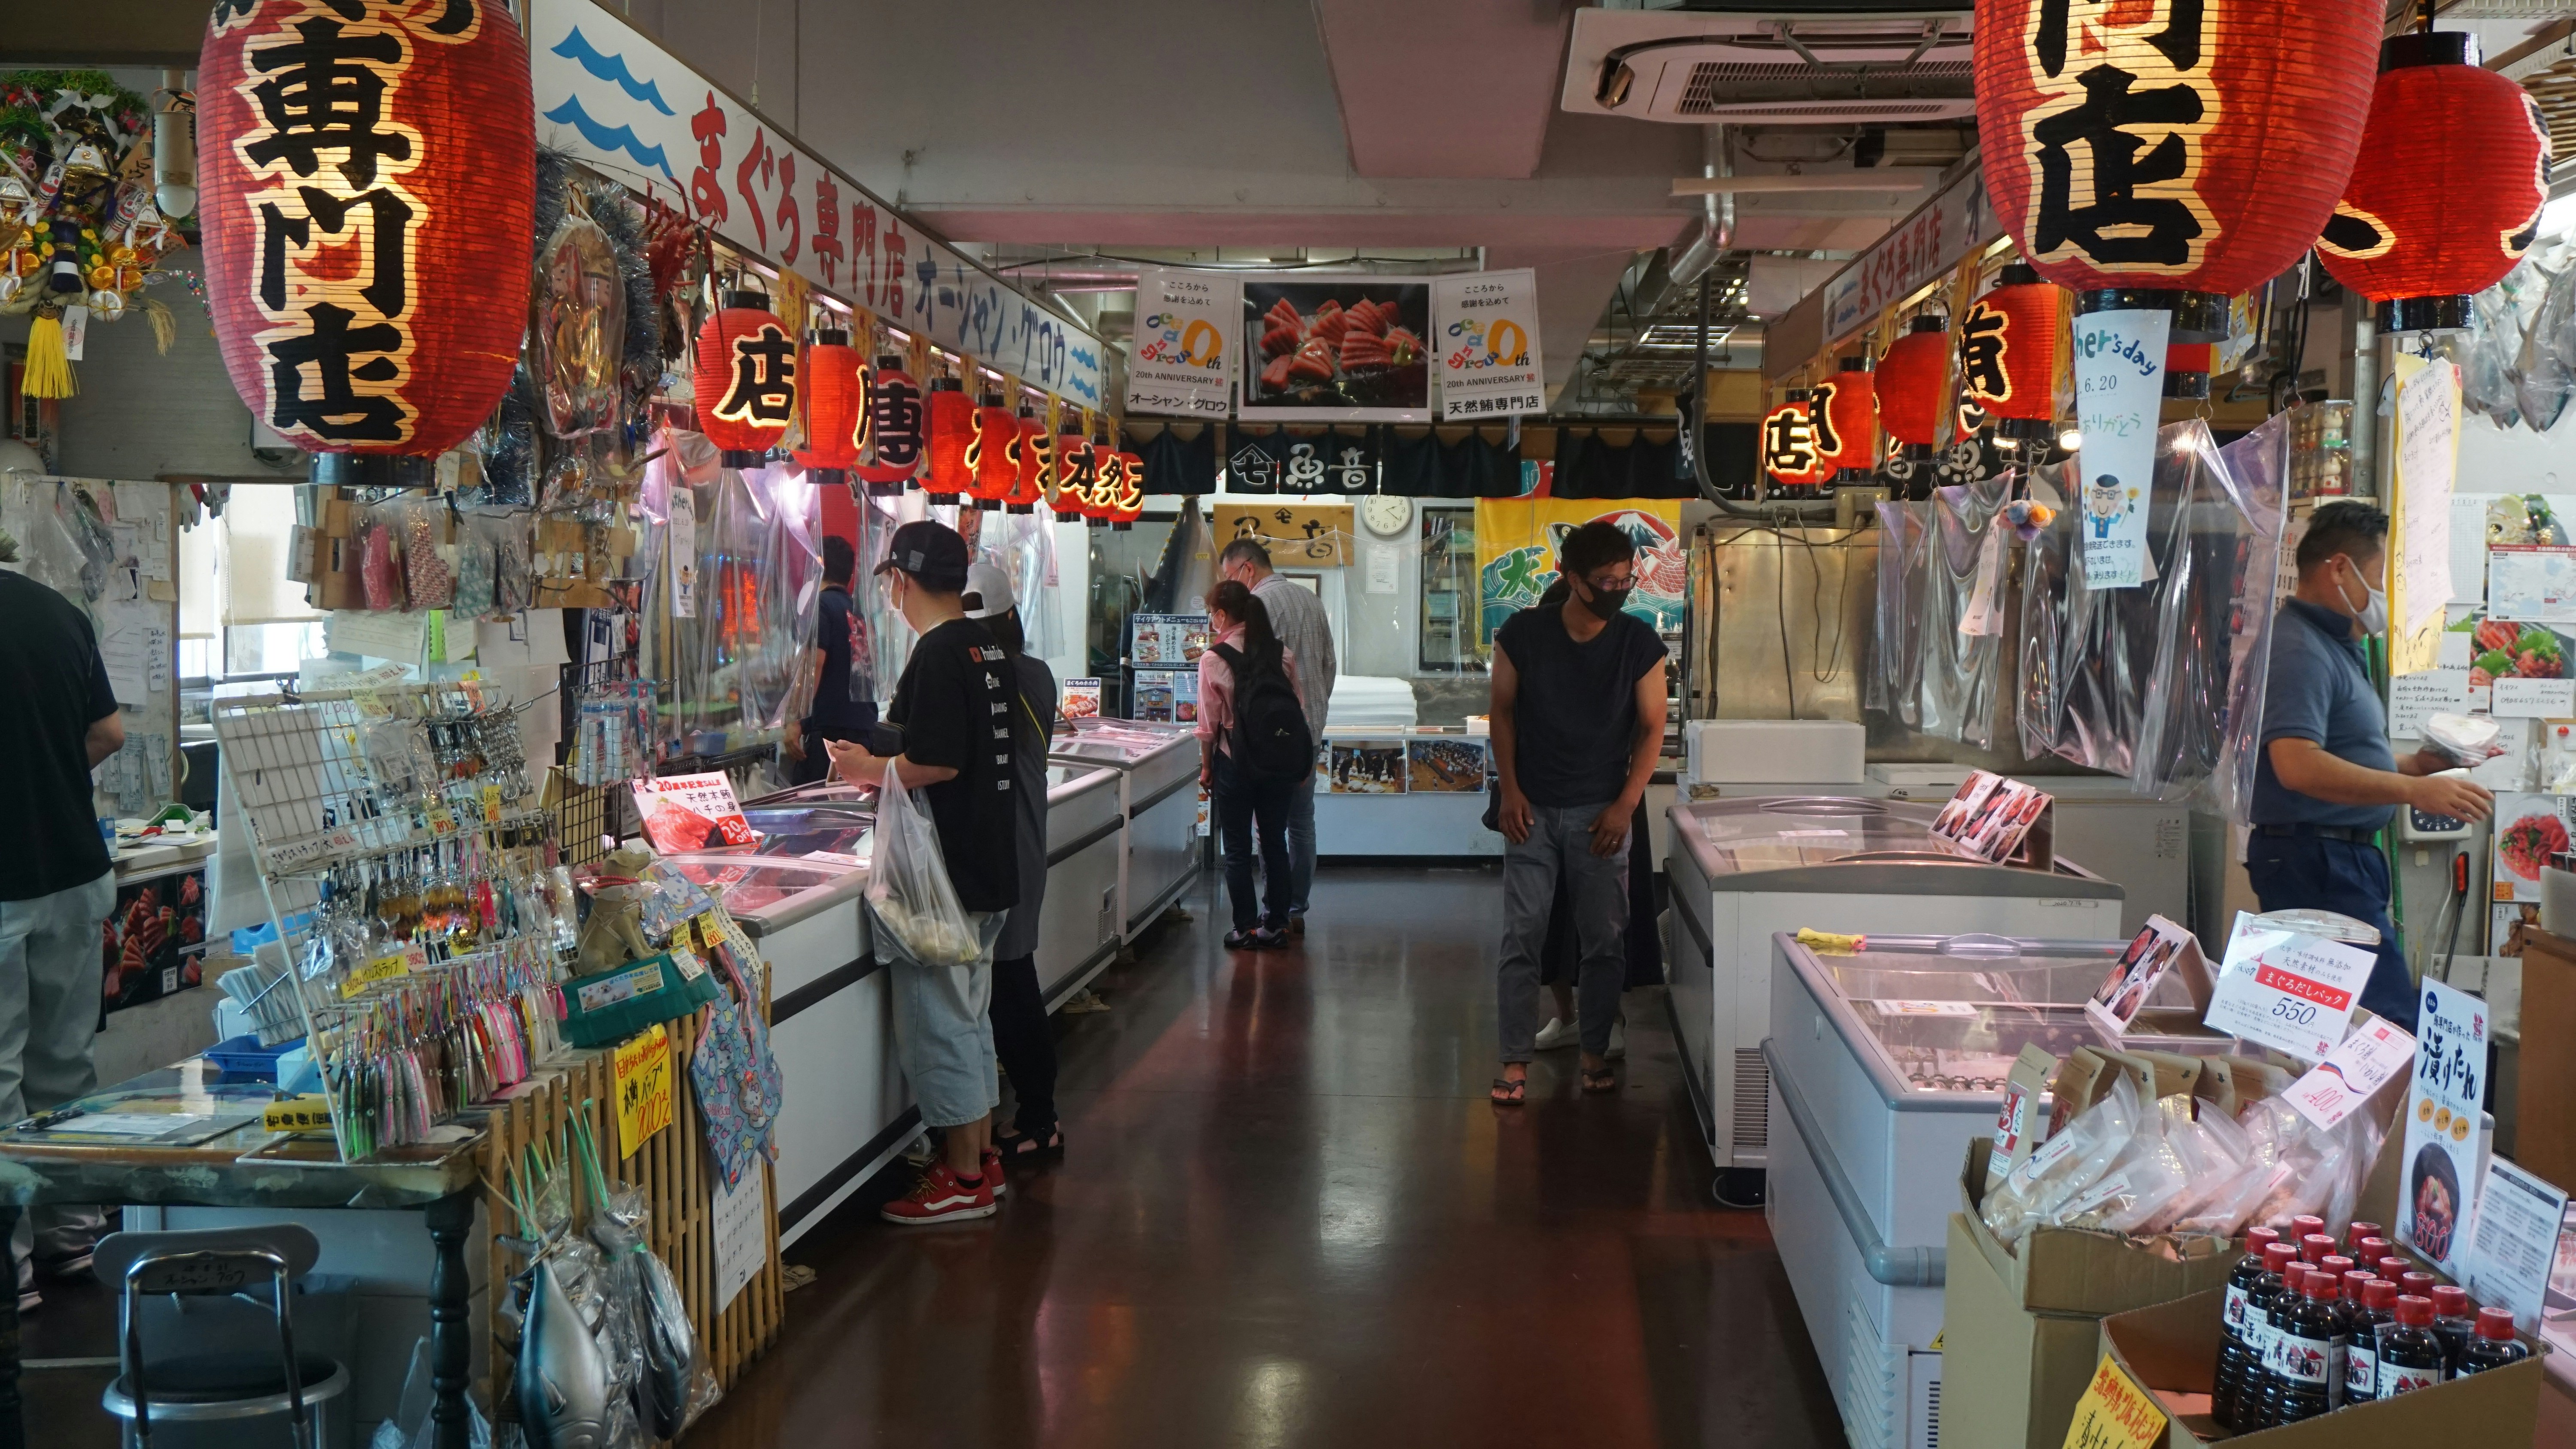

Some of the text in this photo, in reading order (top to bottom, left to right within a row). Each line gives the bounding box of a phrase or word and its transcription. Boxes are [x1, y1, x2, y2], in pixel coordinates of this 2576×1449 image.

[691, 90, 906, 319] まぐろ専門店
[1860, 203, 1943, 315] まぐろ専門店
[1170, 282, 1209, 291] こころから
[1465, 284, 1504, 294] こころから
[1163, 294, 1212, 306] 感謝を込めて
[1461, 297, 1509, 308] 感謝を込めて
[719, 326, 794, 421] 店
[1155, 373, 1214, 385] ANNIVERSARY
[1467, 374, 1525, 386] ANNIVERSARY
[1449, 395, 1539, 414] 天然鮪専門店
[1765, 412, 1814, 471] 店
[2285, 552, 2290, 566] 2
[1498, 550, 1542, 600] 大
[980, 644, 1005, 660] PandaTube
[994, 728, 1009, 739] HANNEL
[656, 779, 721, 791] 20周年記念SALE
[997, 779, 1010, 791] ISTORY
[686, 789, 731, 803] 天然本鮪
[693, 801, 736, 815] ハチの身
[736, 829, 750, 843] OFF
[2283, 957, 2342, 982] 天然素材のみを使用
[2326, 958, 2351, 970] 無添加
[2265, 972, 2342, 1005] まぐろだしパック
[2415, 1212, 2447, 1261] 800
